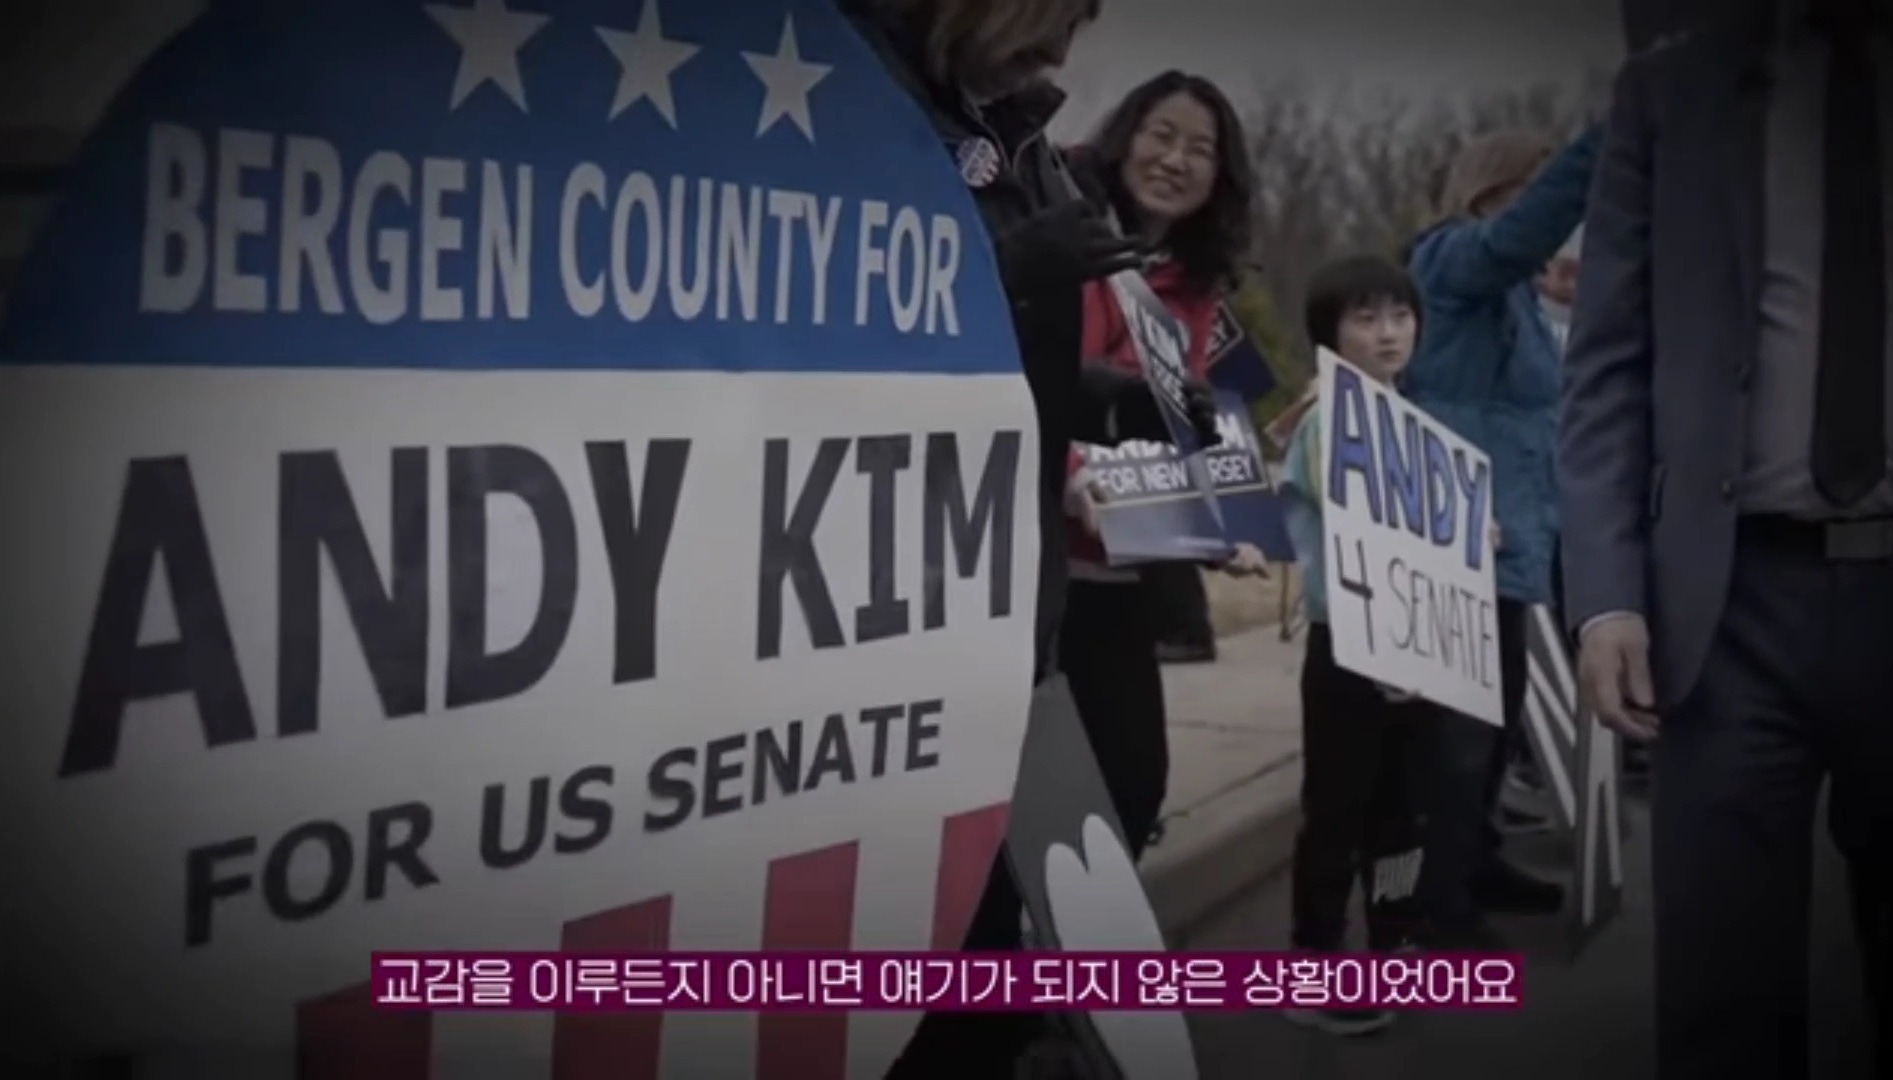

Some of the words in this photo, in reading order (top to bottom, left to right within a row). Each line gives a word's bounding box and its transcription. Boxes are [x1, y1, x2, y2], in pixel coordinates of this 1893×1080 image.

[138, 122, 532, 325] BERGEN
[559, 162, 841, 325] COUNTY
[855, 200, 960, 336] FOR
[1098, 465, 1143, 494] FOR
[1142, 461, 1189, 491] NEW
[1329, 364, 1487, 570] ANDY
[58, 437, 692, 778] ANDY
[755, 429, 1023, 661] KIM
[1334, 534, 1374, 655] 4
[1388, 557, 1494, 689] SENATE
[184, 800, 440, 948] FOR
[478, 764, 614, 869] US
[642, 699, 943, 834] SENATE
